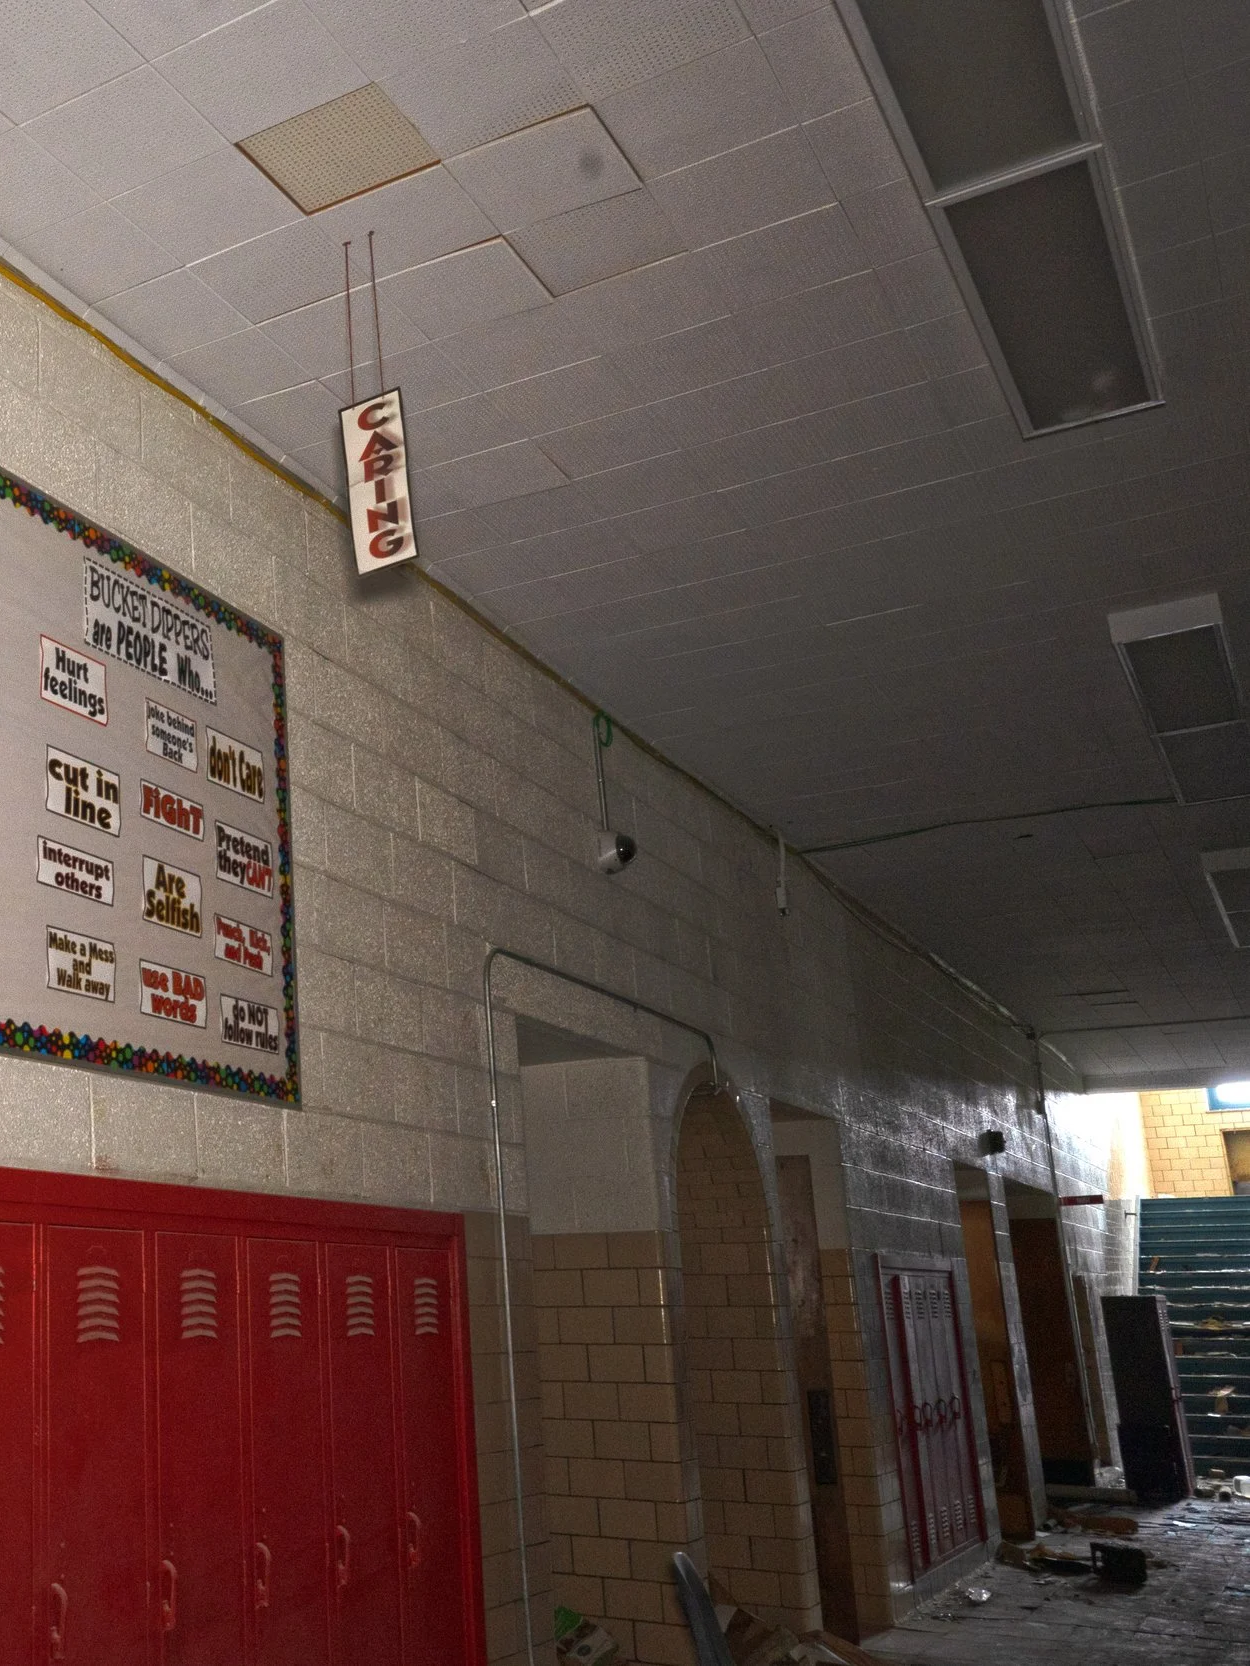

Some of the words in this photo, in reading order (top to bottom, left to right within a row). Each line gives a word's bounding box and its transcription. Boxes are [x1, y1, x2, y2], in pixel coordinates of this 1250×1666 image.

[357, 402, 404, 559] CARING
[89, 565, 148, 628] BUCKET
[150, 600, 210, 661] DIPPERS
[55, 646, 89, 684] Hurt
[92, 618, 112, 651] are
[116, 620, 168, 677] PEOPLE
[43, 667, 105, 717] feelings
[151, 724, 193, 754] someone's
[166, 710, 195, 738] behind
[162, 742, 183, 764] Back
[209, 735, 237, 789] don't
[48, 757, 89, 792] cut
[96, 769, 119, 804] in
[64, 785, 112, 830] line
[42, 839, 111, 881] interrupt
[217, 825, 270, 867] Pretend
[54, 871, 103, 900] others
[154, 862, 187, 899] Are
[218, 848, 246, 886] they
[145, 888, 201, 934] Selfish
[48, 930, 77, 955] Make
[79, 942, 87, 957] a
[88, 941, 114, 965] Mess
[56, 967, 82, 991] Walk
[84, 978, 111, 1001] away
[72, 957, 92, 976] and
[141, 966, 169, 993] use
[171, 970, 205, 1002] BAD
[150, 993, 197, 1024] words
[233, 1000, 247, 1023] do
[247, 1003, 269, 1027] NOT
[223, 1016, 254, 1046] follow
[255, 1024, 279, 1052] rules
